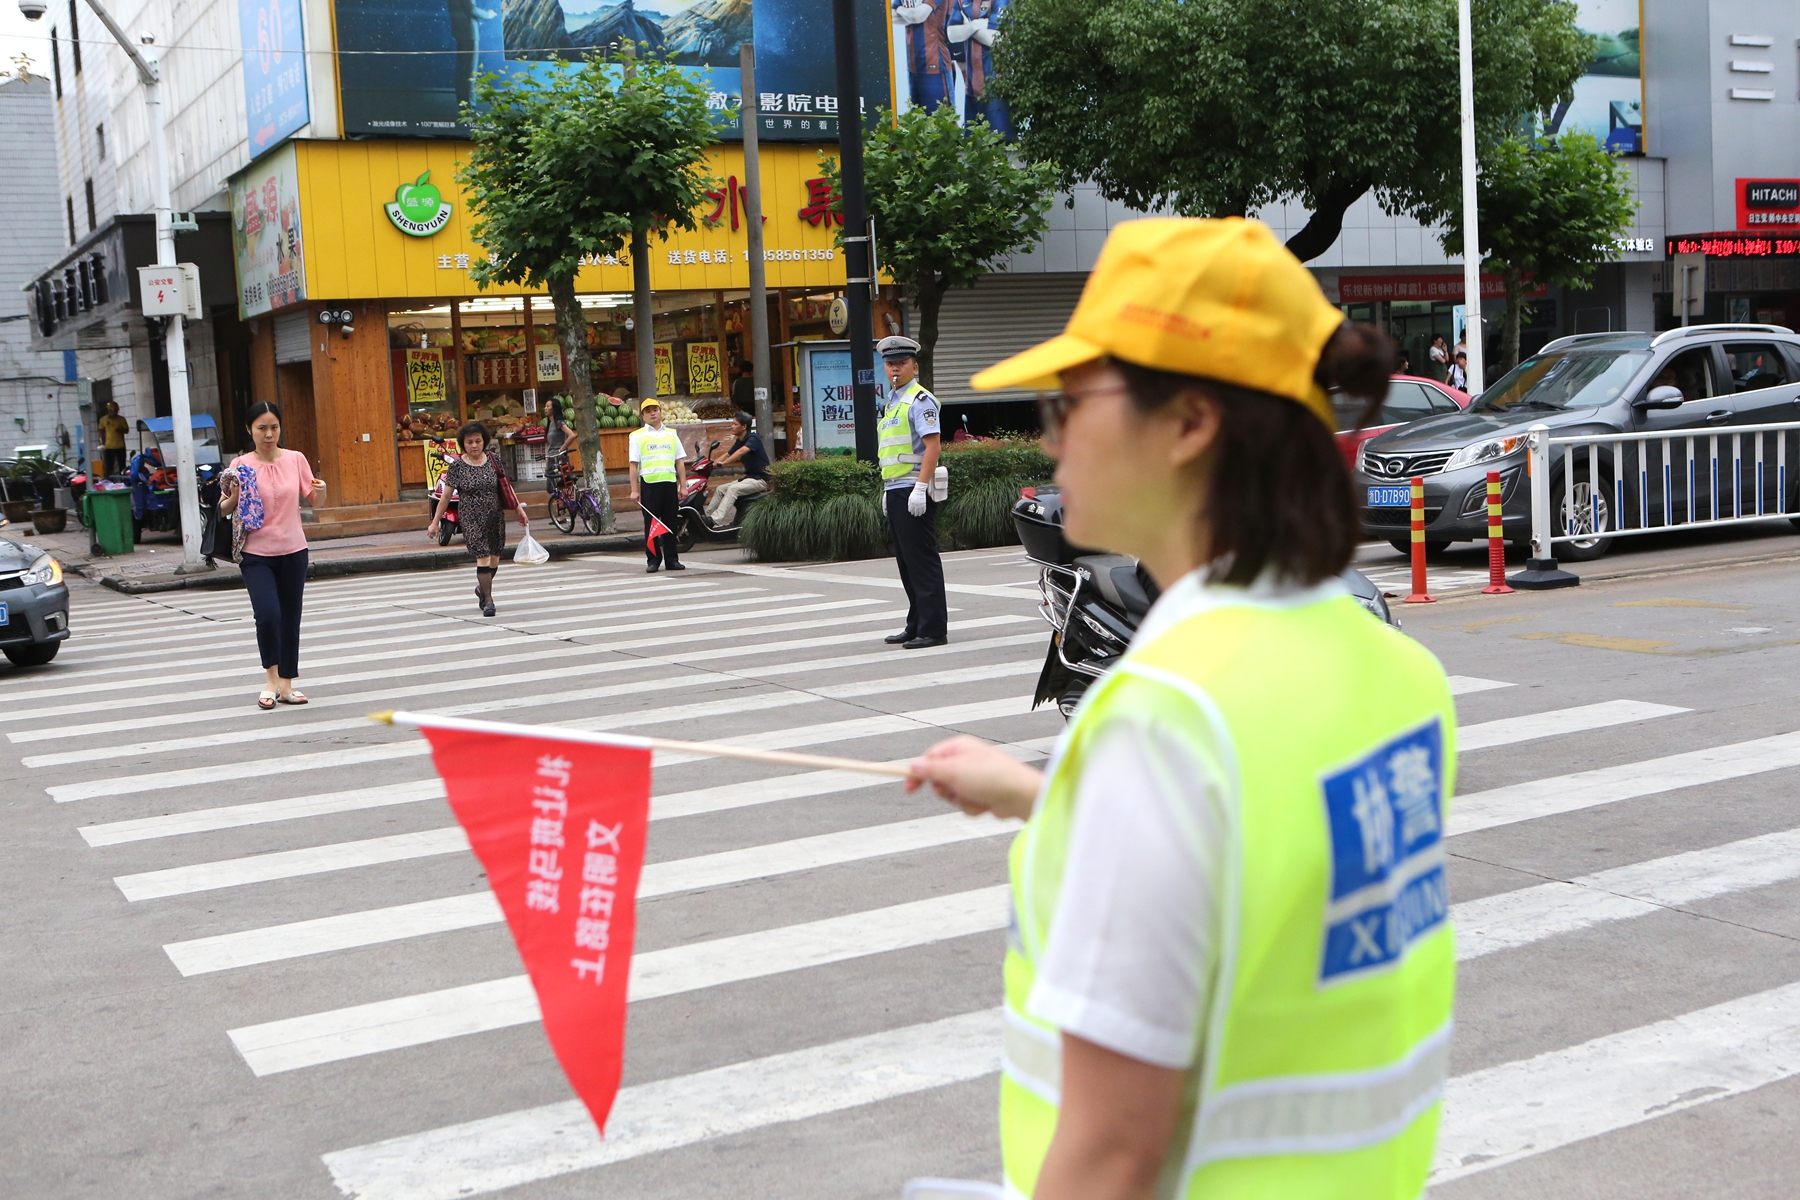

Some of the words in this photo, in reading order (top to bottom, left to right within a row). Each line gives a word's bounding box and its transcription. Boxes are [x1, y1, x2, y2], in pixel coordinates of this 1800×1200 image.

[704, 91, 867, 114] 激影院电
[730, 118, 839, 130] 引世界的看
[1751, 188, 1798, 201] HITACHI
[391, 209, 449, 232] SHENGYUAN
[742, 248, 835, 262] 158561356
